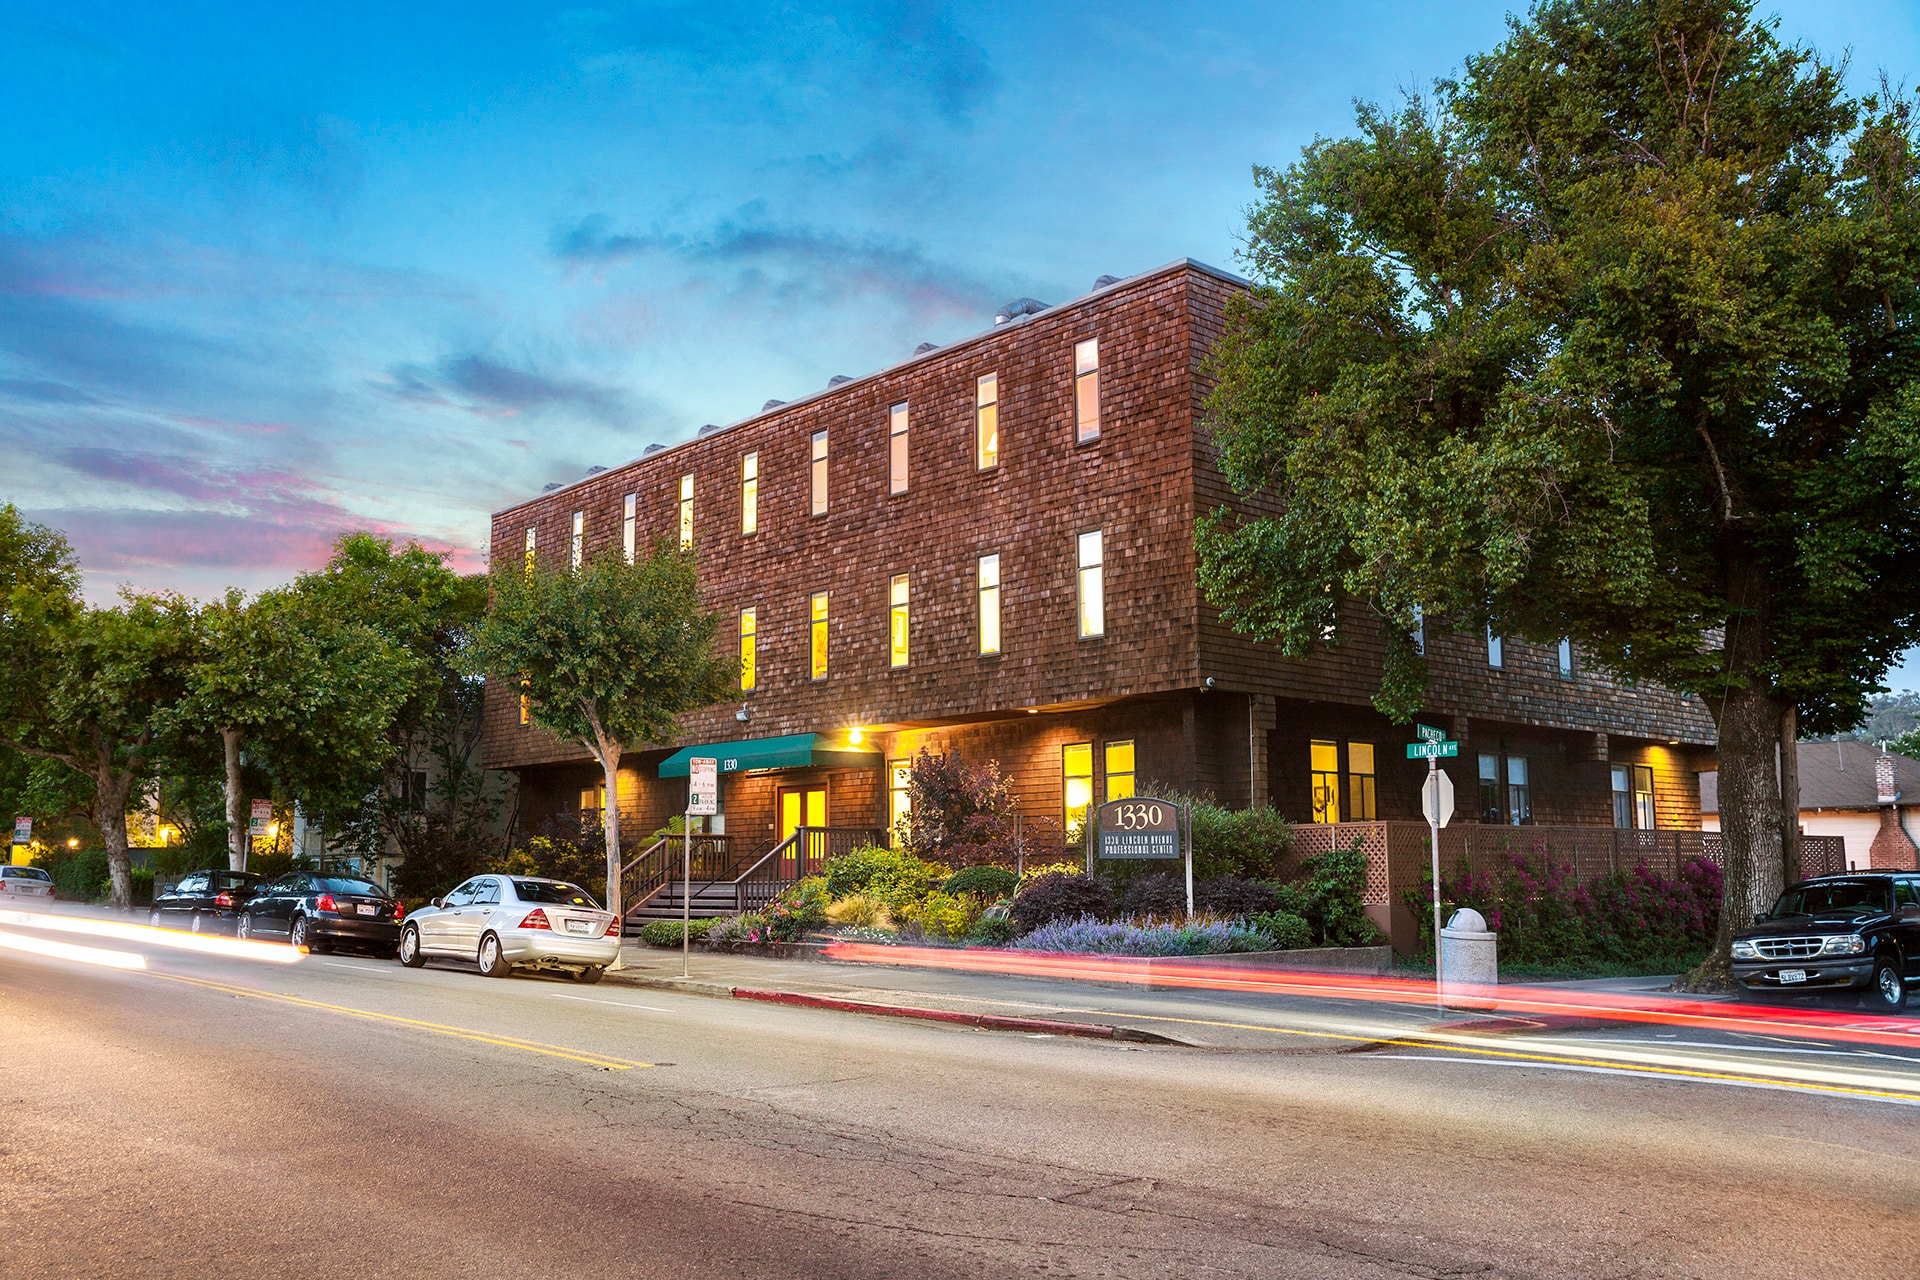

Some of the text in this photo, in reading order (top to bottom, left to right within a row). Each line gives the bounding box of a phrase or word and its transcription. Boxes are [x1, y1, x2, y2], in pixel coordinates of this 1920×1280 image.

[1422, 727, 1442, 741] PACHECO
[1414, 744, 1448, 756] LINCOLN
[724, 759, 738, 770] 1330
[693, 795, 698, 804] 2
[1114, 804, 1163, 830] 1330
[1122, 835, 1149, 845] LINCOLN
[1151, 835, 1173, 845] AVENUE
[1105, 845, 1173, 854] PROFESSIONAL CENTER
